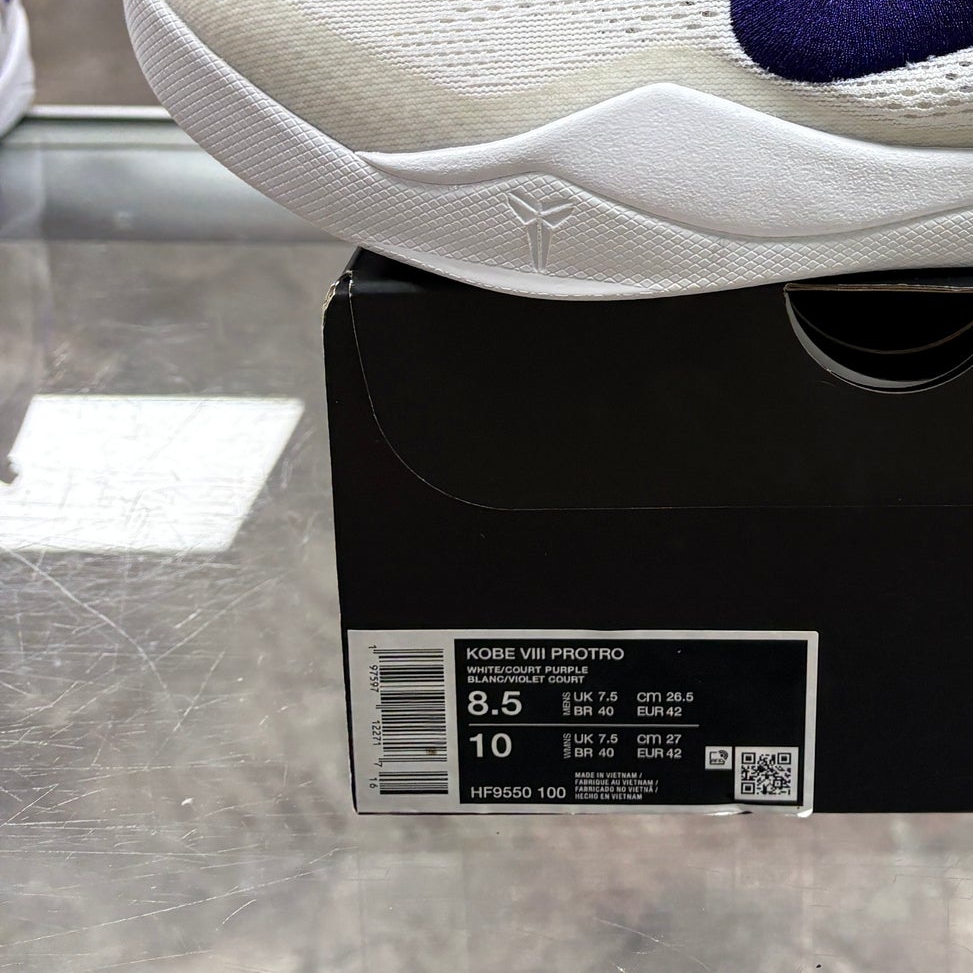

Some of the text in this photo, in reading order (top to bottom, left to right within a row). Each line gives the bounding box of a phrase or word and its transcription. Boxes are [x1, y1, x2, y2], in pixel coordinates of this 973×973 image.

[466, 647, 625, 660] KOBE VIII PROTRO
[466, 666, 589, 674] WHITE/COURT PURPLE
[369, 664, 380, 693] 97597
[467, 675, 585, 684] BLANC/VIOLET COURT
[573, 691, 618, 702] UK 7.5
[666, 691, 694, 702] 26.5
[467, 690, 523, 716] 8.5
[562, 691, 571, 716] MENS
[573, 706, 615, 717] BR 40
[637, 706, 683, 717] EUR 42
[574, 733, 618, 744] UK 7.5
[666, 734, 682, 744] 27
[469, 732, 512, 758] 10
[574, 748, 615, 758] BR 40
[637, 748, 682, 758] EUR 42
[470, 786, 566, 799] HF9550 100
